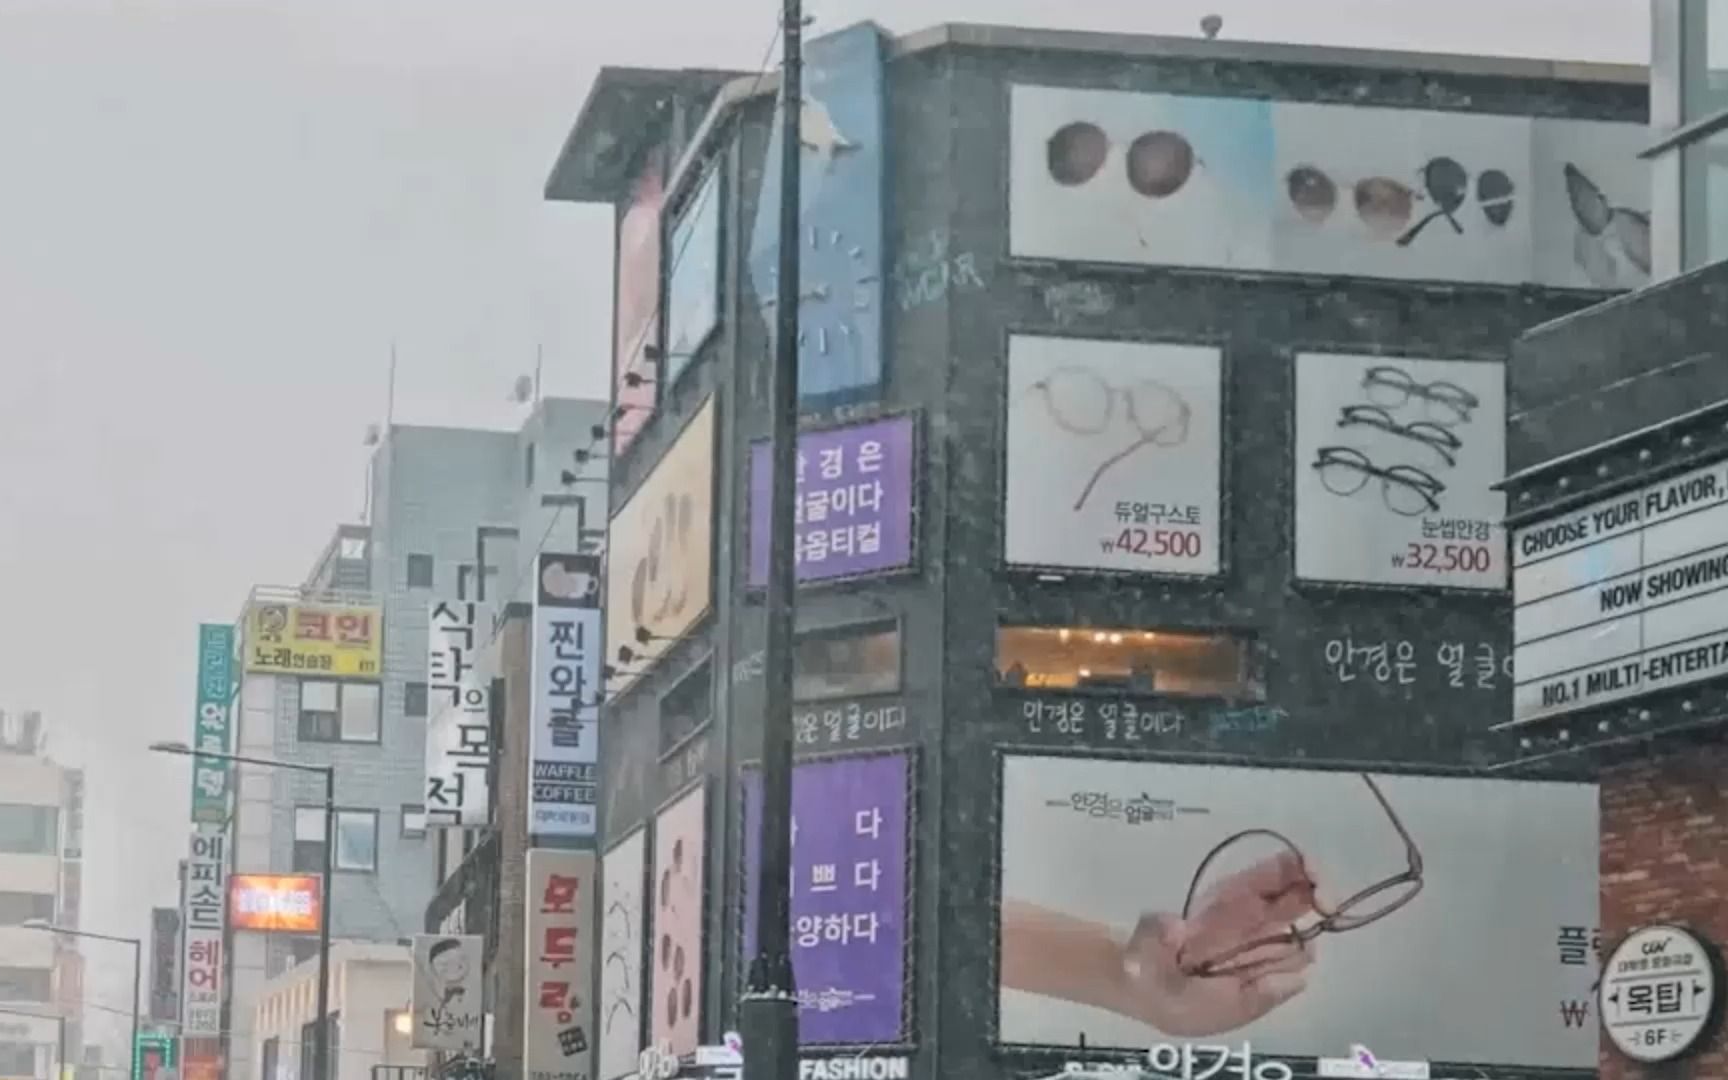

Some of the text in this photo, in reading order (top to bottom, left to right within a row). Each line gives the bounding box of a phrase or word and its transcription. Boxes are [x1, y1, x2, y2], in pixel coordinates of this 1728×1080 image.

[1114, 502, 1201, 525] 듀얼구스토
[1423, 516, 1490, 541] 눈썹안경
[1523, 472, 1723, 557] CHOOSE YOUR FLAVOR,
[1600, 580, 1643, 612] NOW
[295, 611, 372, 650] 코인
[1325, 637, 1417, 684] 안경은
[548, 621, 587, 748] 찐와플
[1543, 678, 1581, 706] NO.1
[535, 763, 594, 780] WAFFLE
[534, 785, 594, 802] COFFEE
[189, 837, 222, 930] 에피소드
[188, 941, 219, 990] 헤어
[1628, 982, 1682, 1014] 옥탑
[1645, 1029, 1667, 1046] 6F
